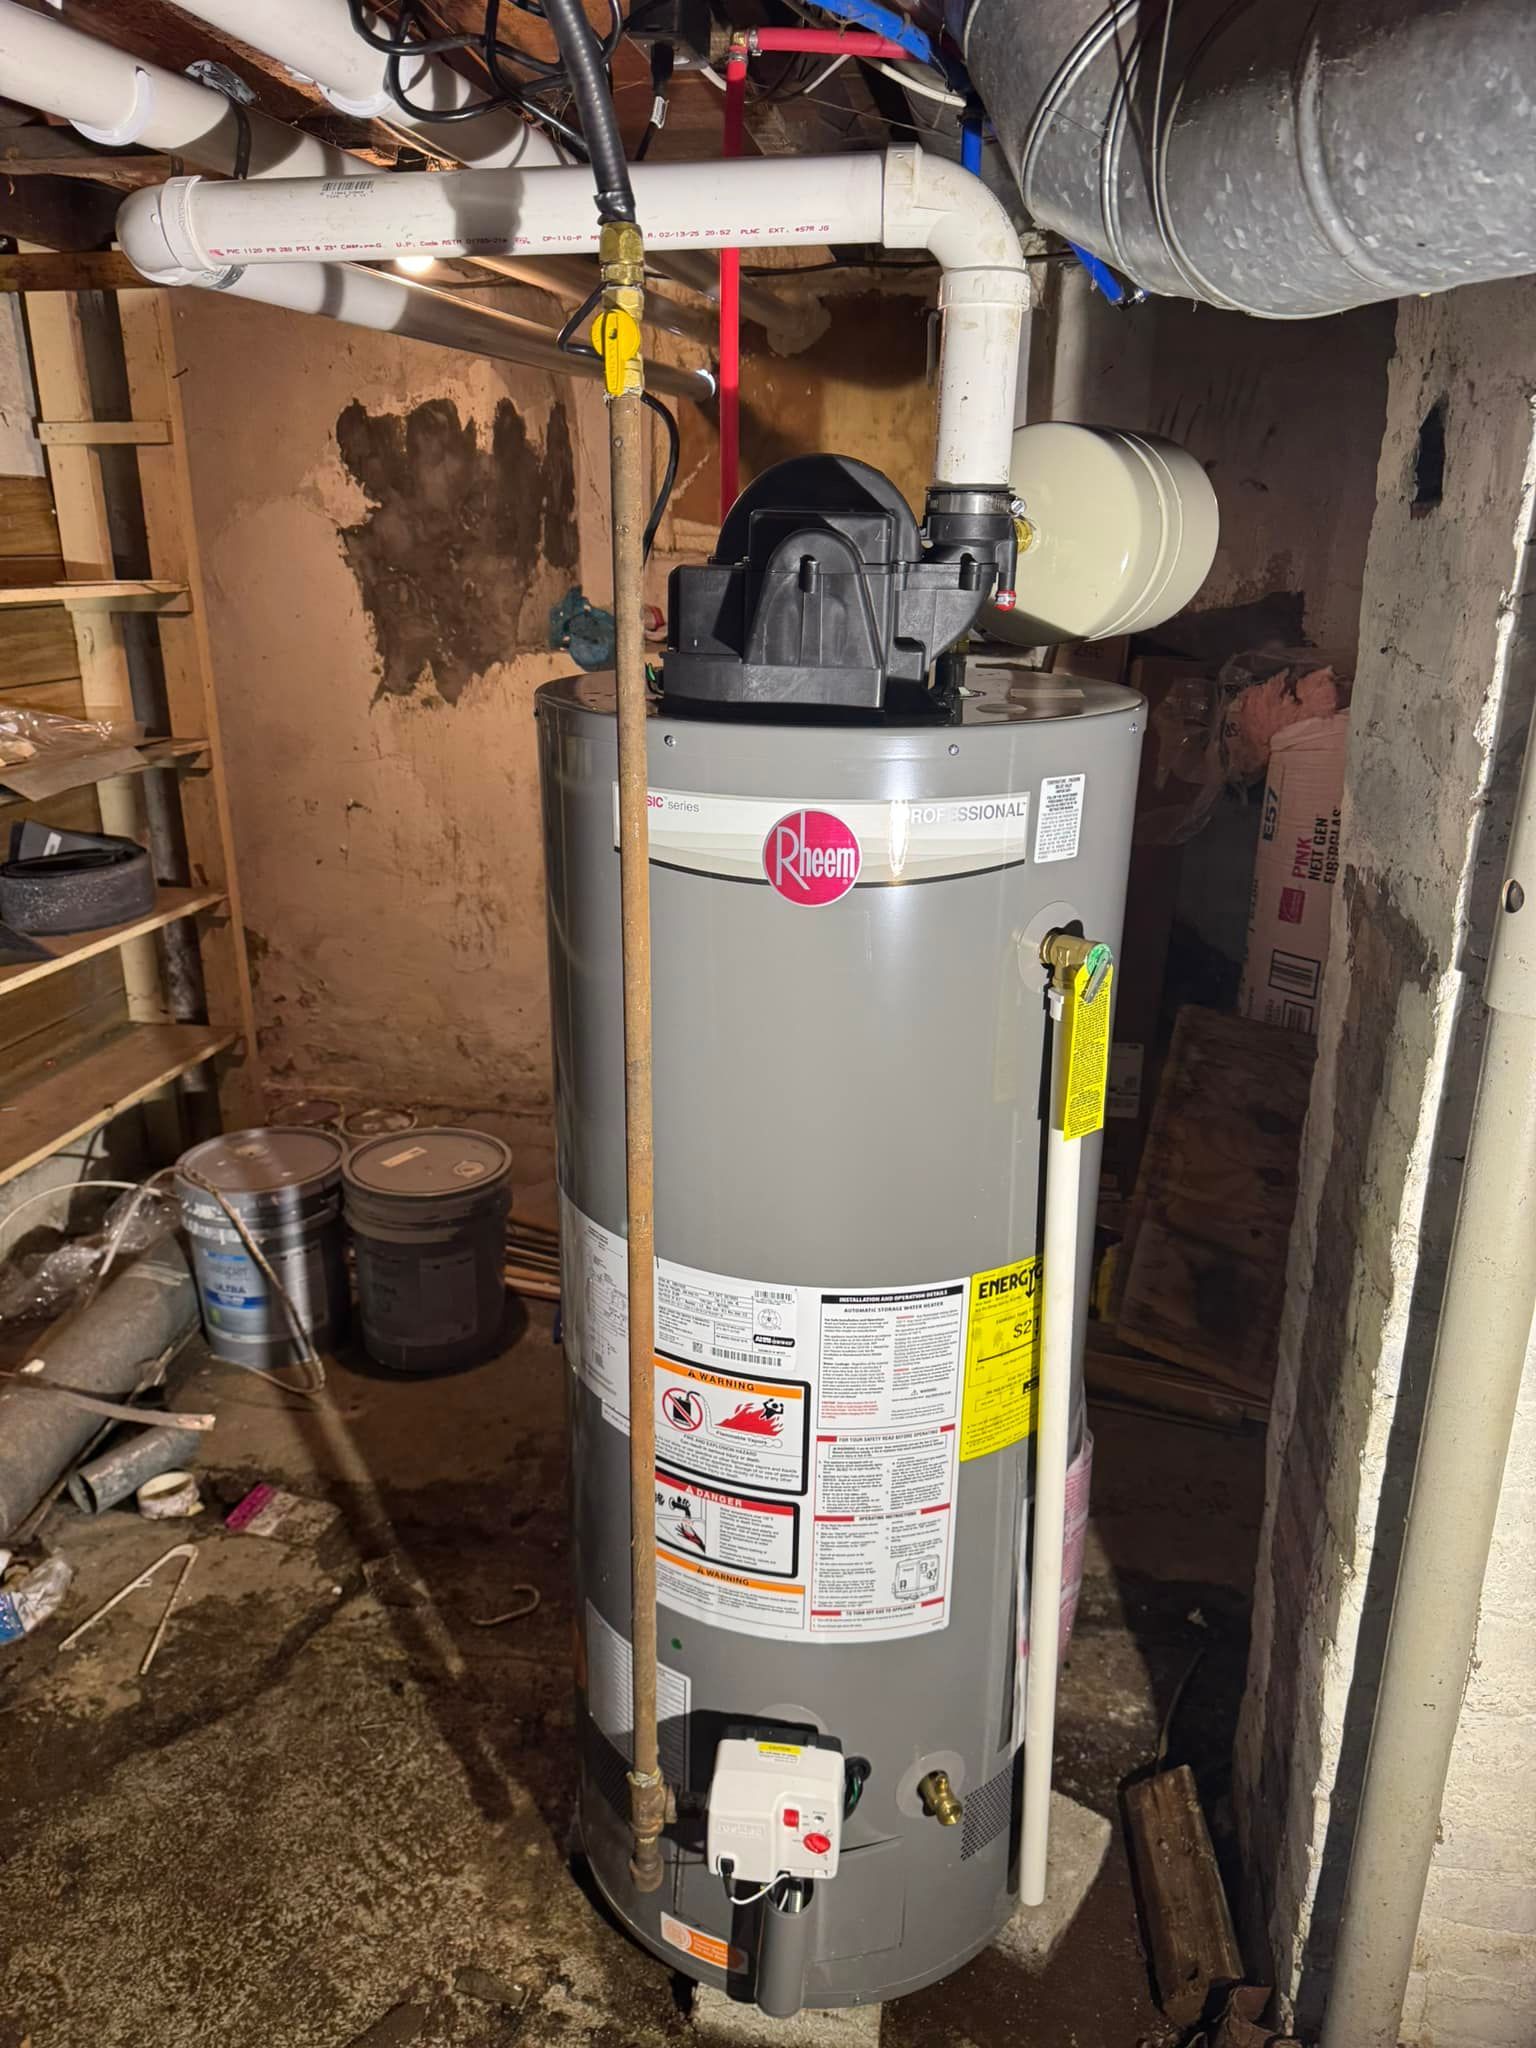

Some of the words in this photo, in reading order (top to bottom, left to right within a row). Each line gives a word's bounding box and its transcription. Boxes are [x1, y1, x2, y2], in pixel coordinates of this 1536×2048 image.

[442, 239, 462, 247] ASTM
[768, 226, 790, 234] EXT.
[668, 800, 700, 813] series
[911, 802, 1025, 824] ROFESSIONAL
[1262, 787, 1279, 841] E57
[1314, 818, 1328, 845] GEN
[775, 810, 855, 890] Rheem
[1292, 837, 1312, 879] PINK
[1308, 851, 1325, 881] NEXT
[894, 1293, 925, 1301] OPERATION
[923, 1301, 943, 1309] HEATER
[700, 1372, 755, 1392] WARNING
[695, 1491, 743, 1507] DANGER
[705, 1568, 750, 1586] WARNING
